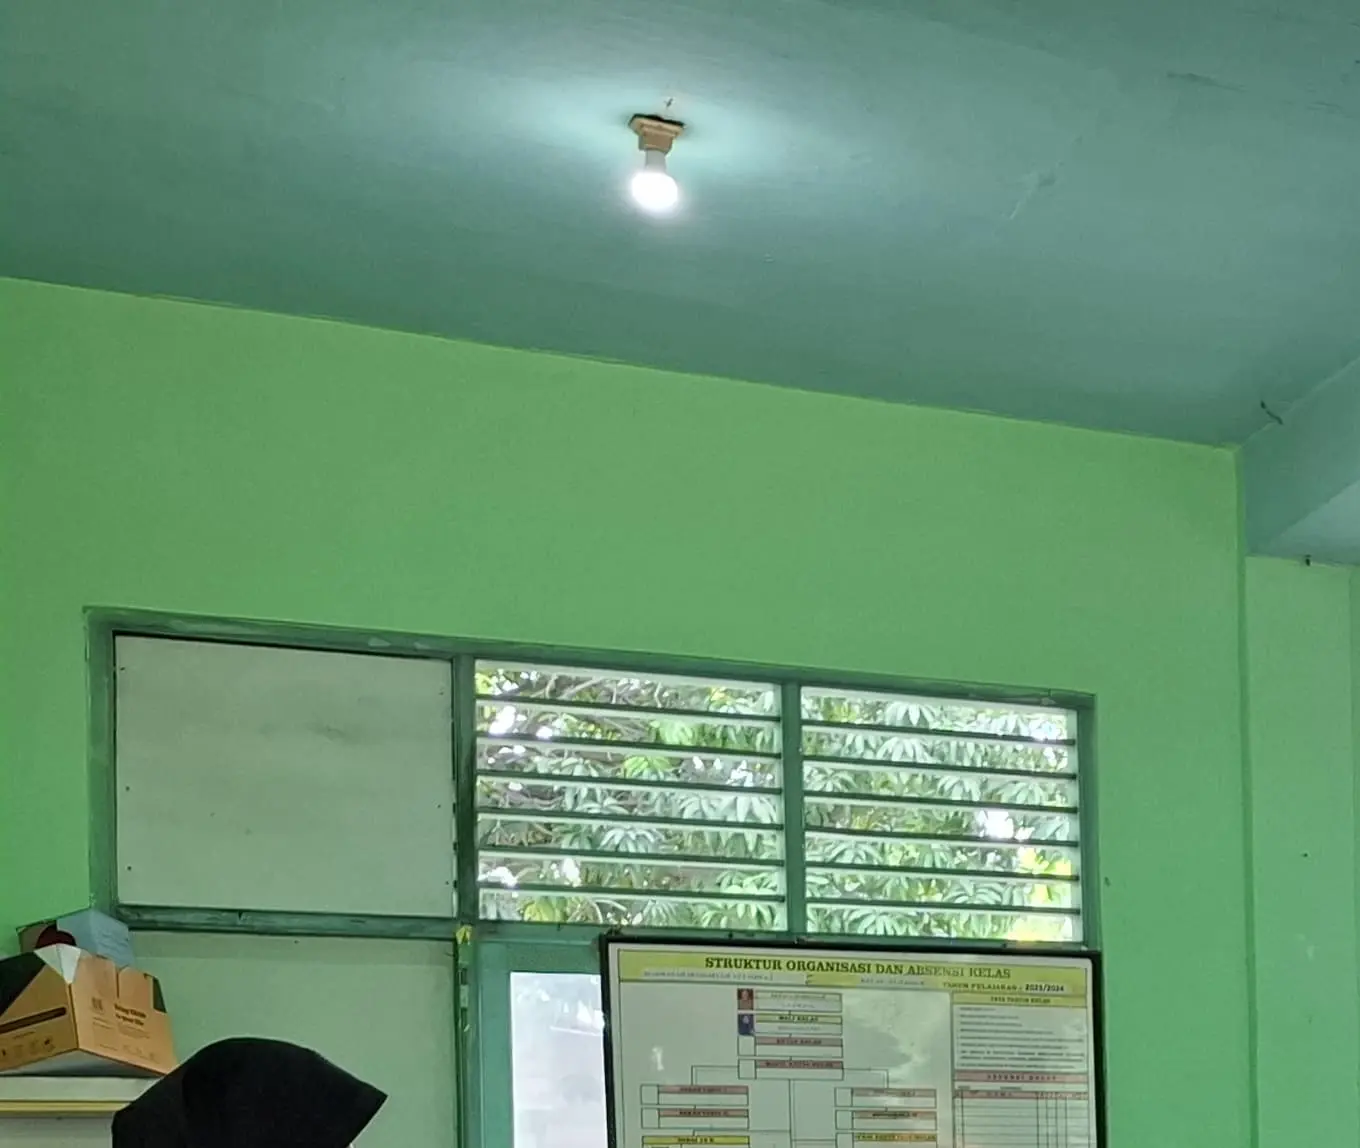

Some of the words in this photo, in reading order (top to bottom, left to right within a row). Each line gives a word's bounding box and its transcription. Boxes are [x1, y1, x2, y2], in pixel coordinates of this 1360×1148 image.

[705, 956, 783, 971] STRUKTUR
[786, 960, 871, 974] ORGANISASI
[875, 963, 904, 975] DAN
[905, 964, 965, 977] ABSENSI
[969, 966, 1011, 979] KELAS
